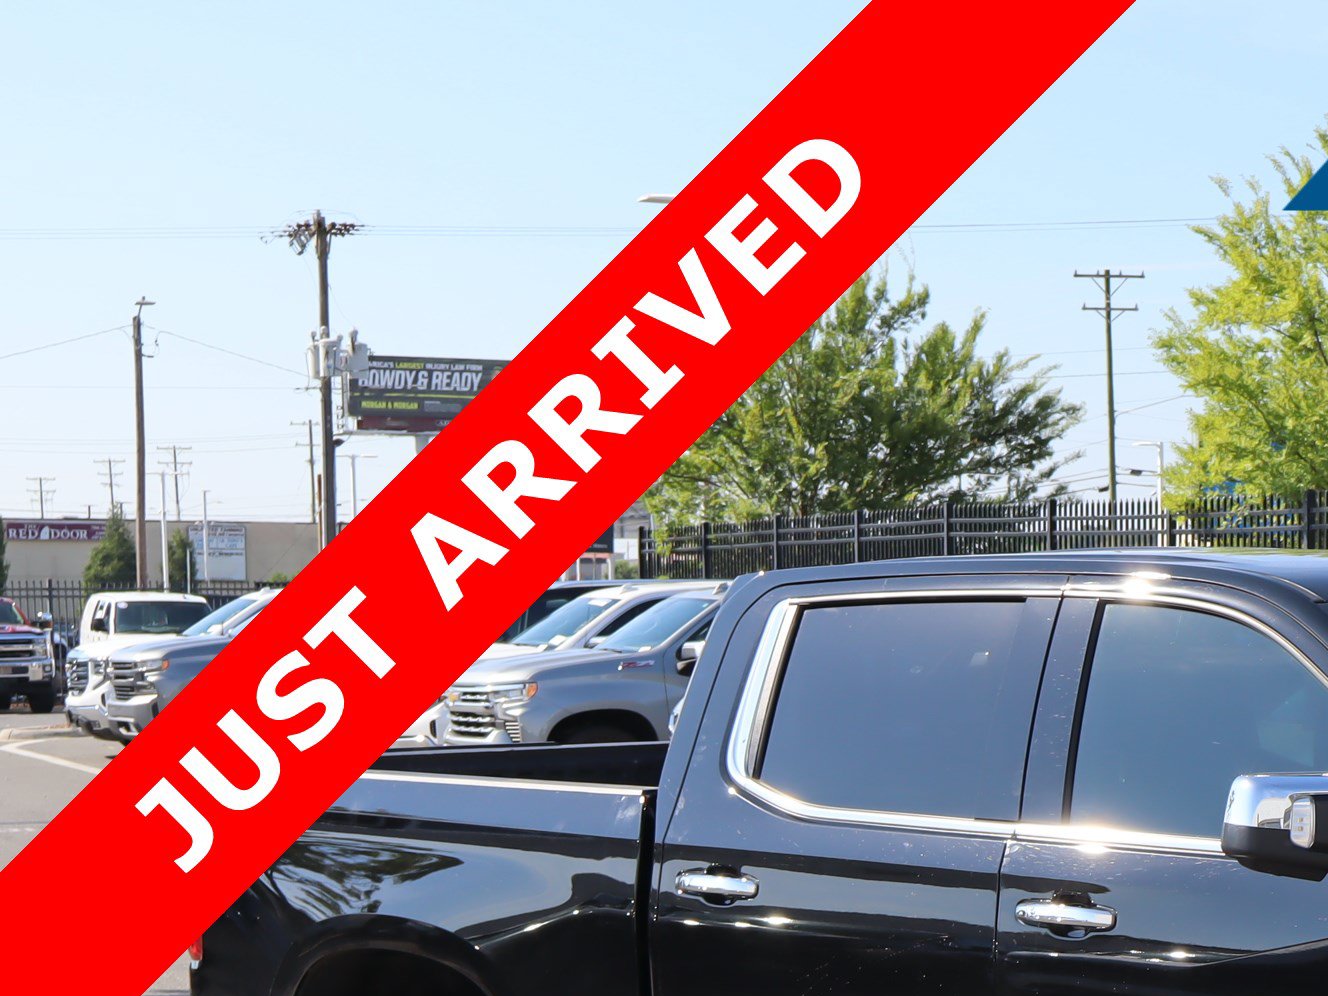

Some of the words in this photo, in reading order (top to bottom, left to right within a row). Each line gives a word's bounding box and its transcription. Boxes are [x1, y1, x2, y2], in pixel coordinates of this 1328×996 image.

[431, 372, 482, 391] READY
[8, 528, 38, 539] RED
[50, 528, 88, 539] DOOR
